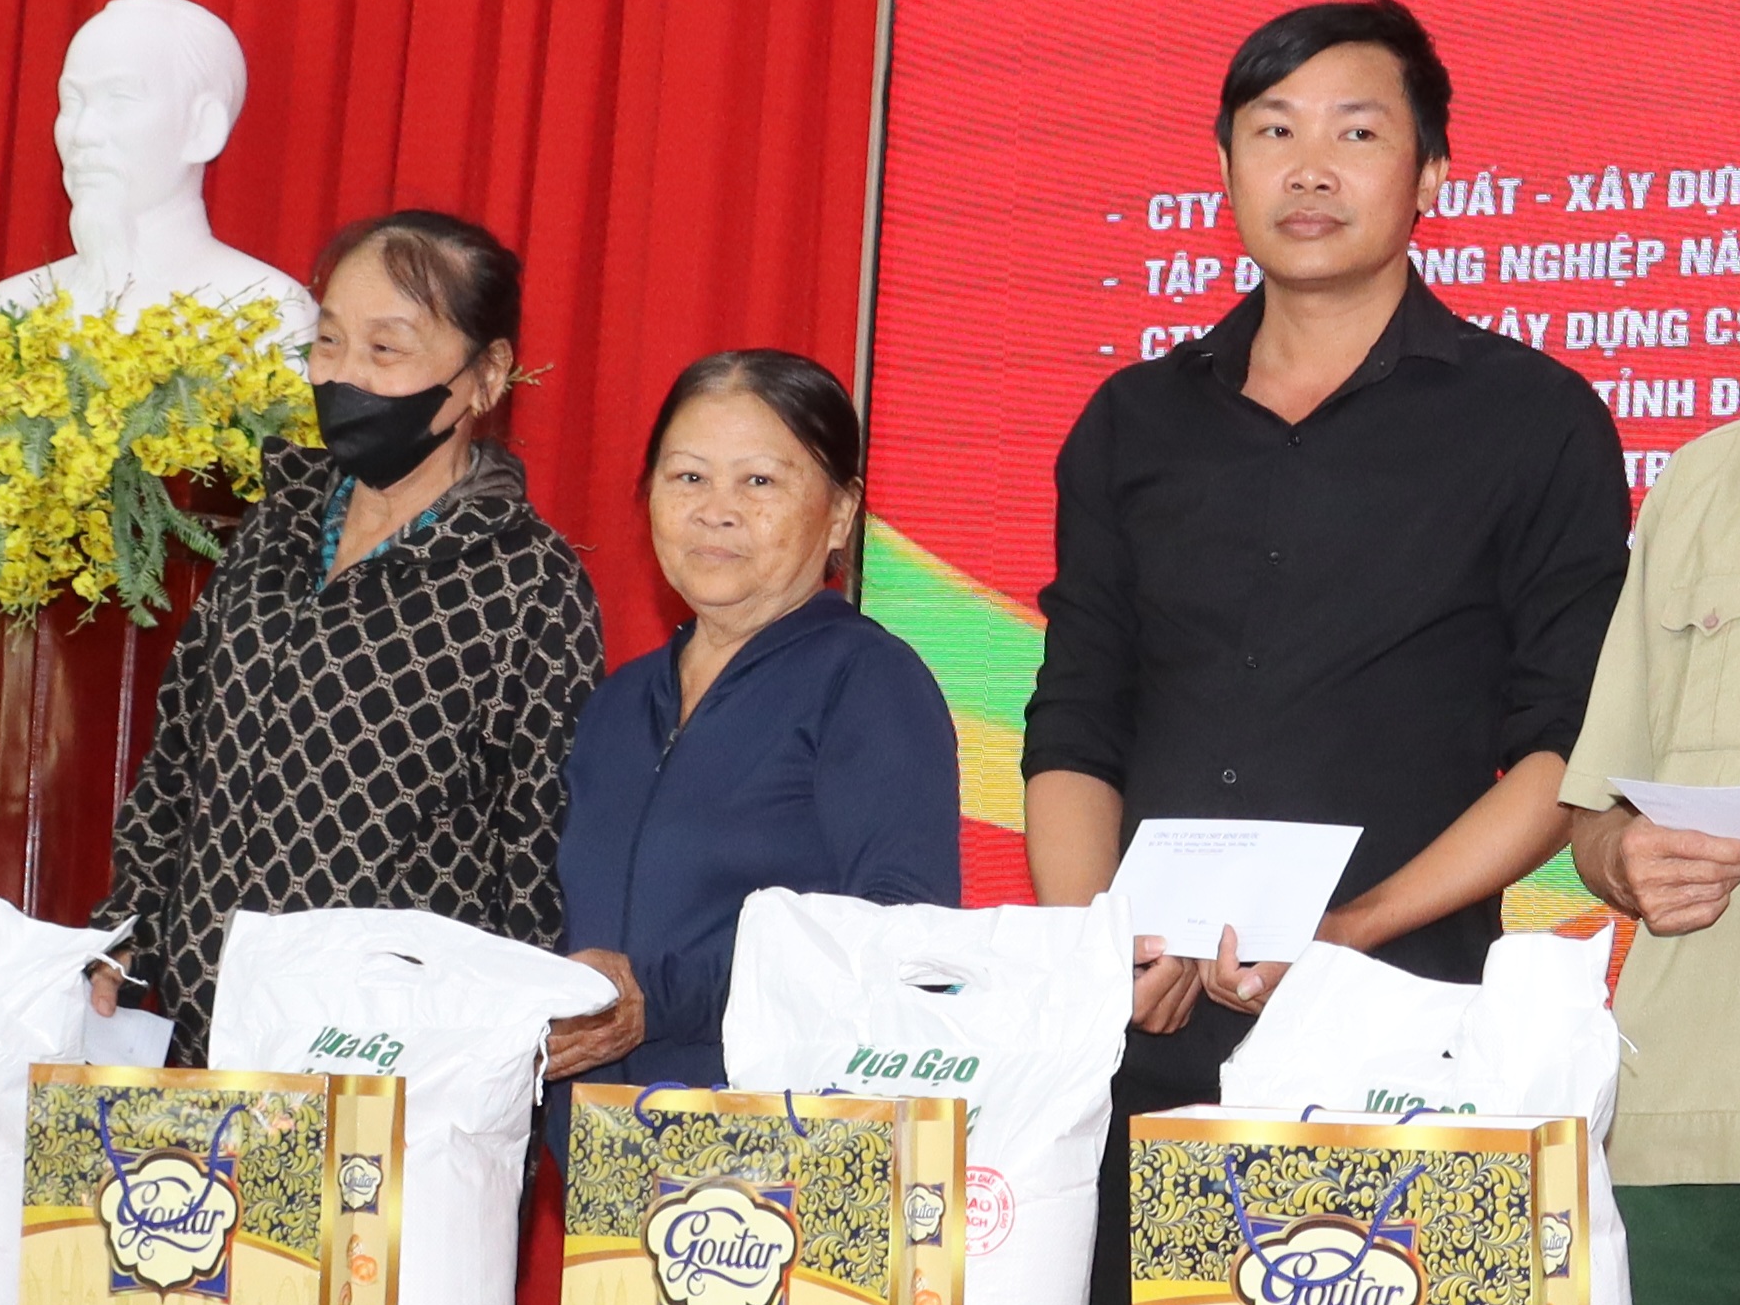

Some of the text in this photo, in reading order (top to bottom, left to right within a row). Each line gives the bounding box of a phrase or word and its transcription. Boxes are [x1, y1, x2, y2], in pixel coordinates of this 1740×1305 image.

[1147, 192, 1222, 231] CTY
[1565, 165, 1654, 213] XÂY
[1144, 250, 1222, 303] TẬP
[1500, 232, 1665, 287] NGHIỆP
[1566, 307, 1689, 357] DỰNG
[1592, 367, 1695, 419] TỈNH
[844, 1043, 981, 1086] Vựa Gạo
[116, 1178, 224, 1262] Goutar
[662, 1206, 783, 1296] Goutar
